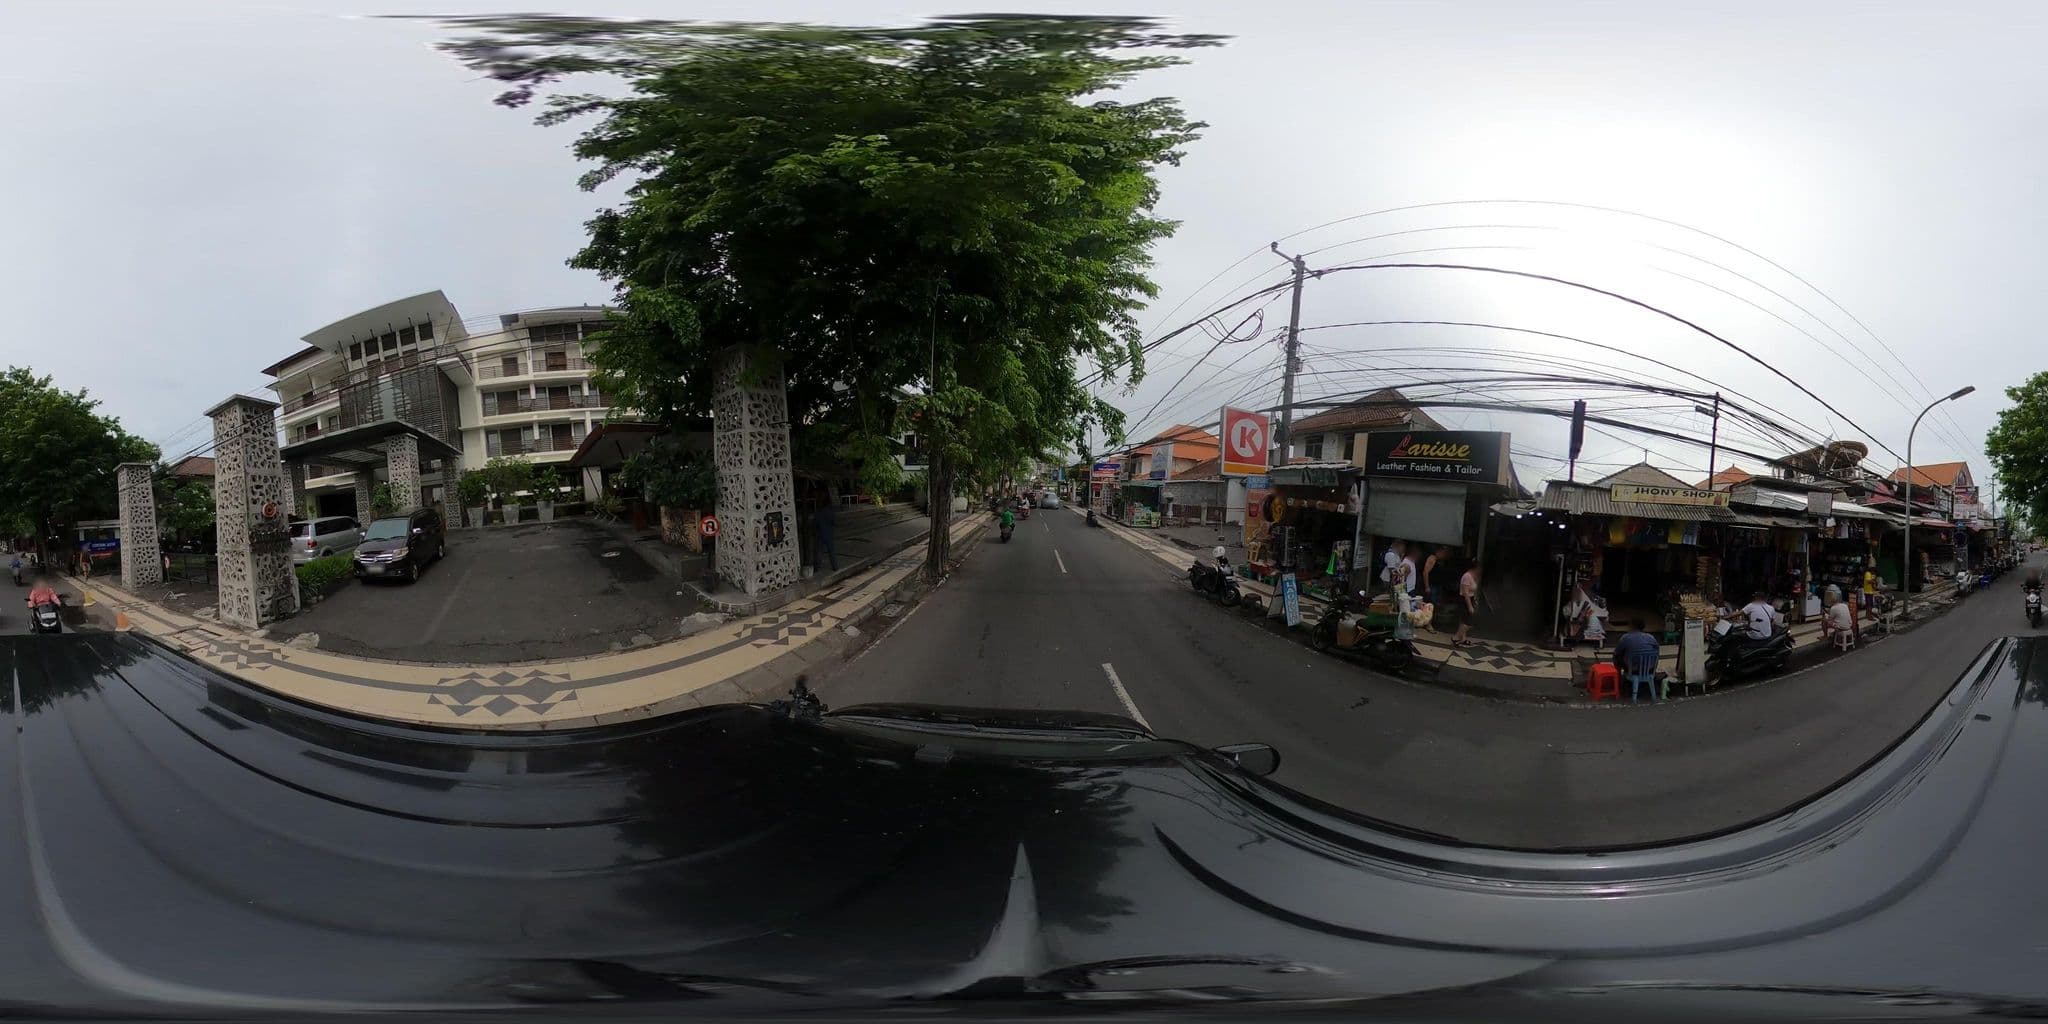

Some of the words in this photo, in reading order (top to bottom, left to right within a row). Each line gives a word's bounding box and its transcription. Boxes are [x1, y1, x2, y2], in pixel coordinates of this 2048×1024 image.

[1240, 425, 1261, 455] K
[1389, 434, 1471, 458] Larisse
[1377, 461, 1407, 471] Leather
[1410, 463, 1441, 473] Fashion
[1444, 464, 1451, 473] &
[1455, 464, 1482, 475] Tailor
[1634, 487, 1678, 496] JHONY
[1682, 490, 1715, 499] SHOP
